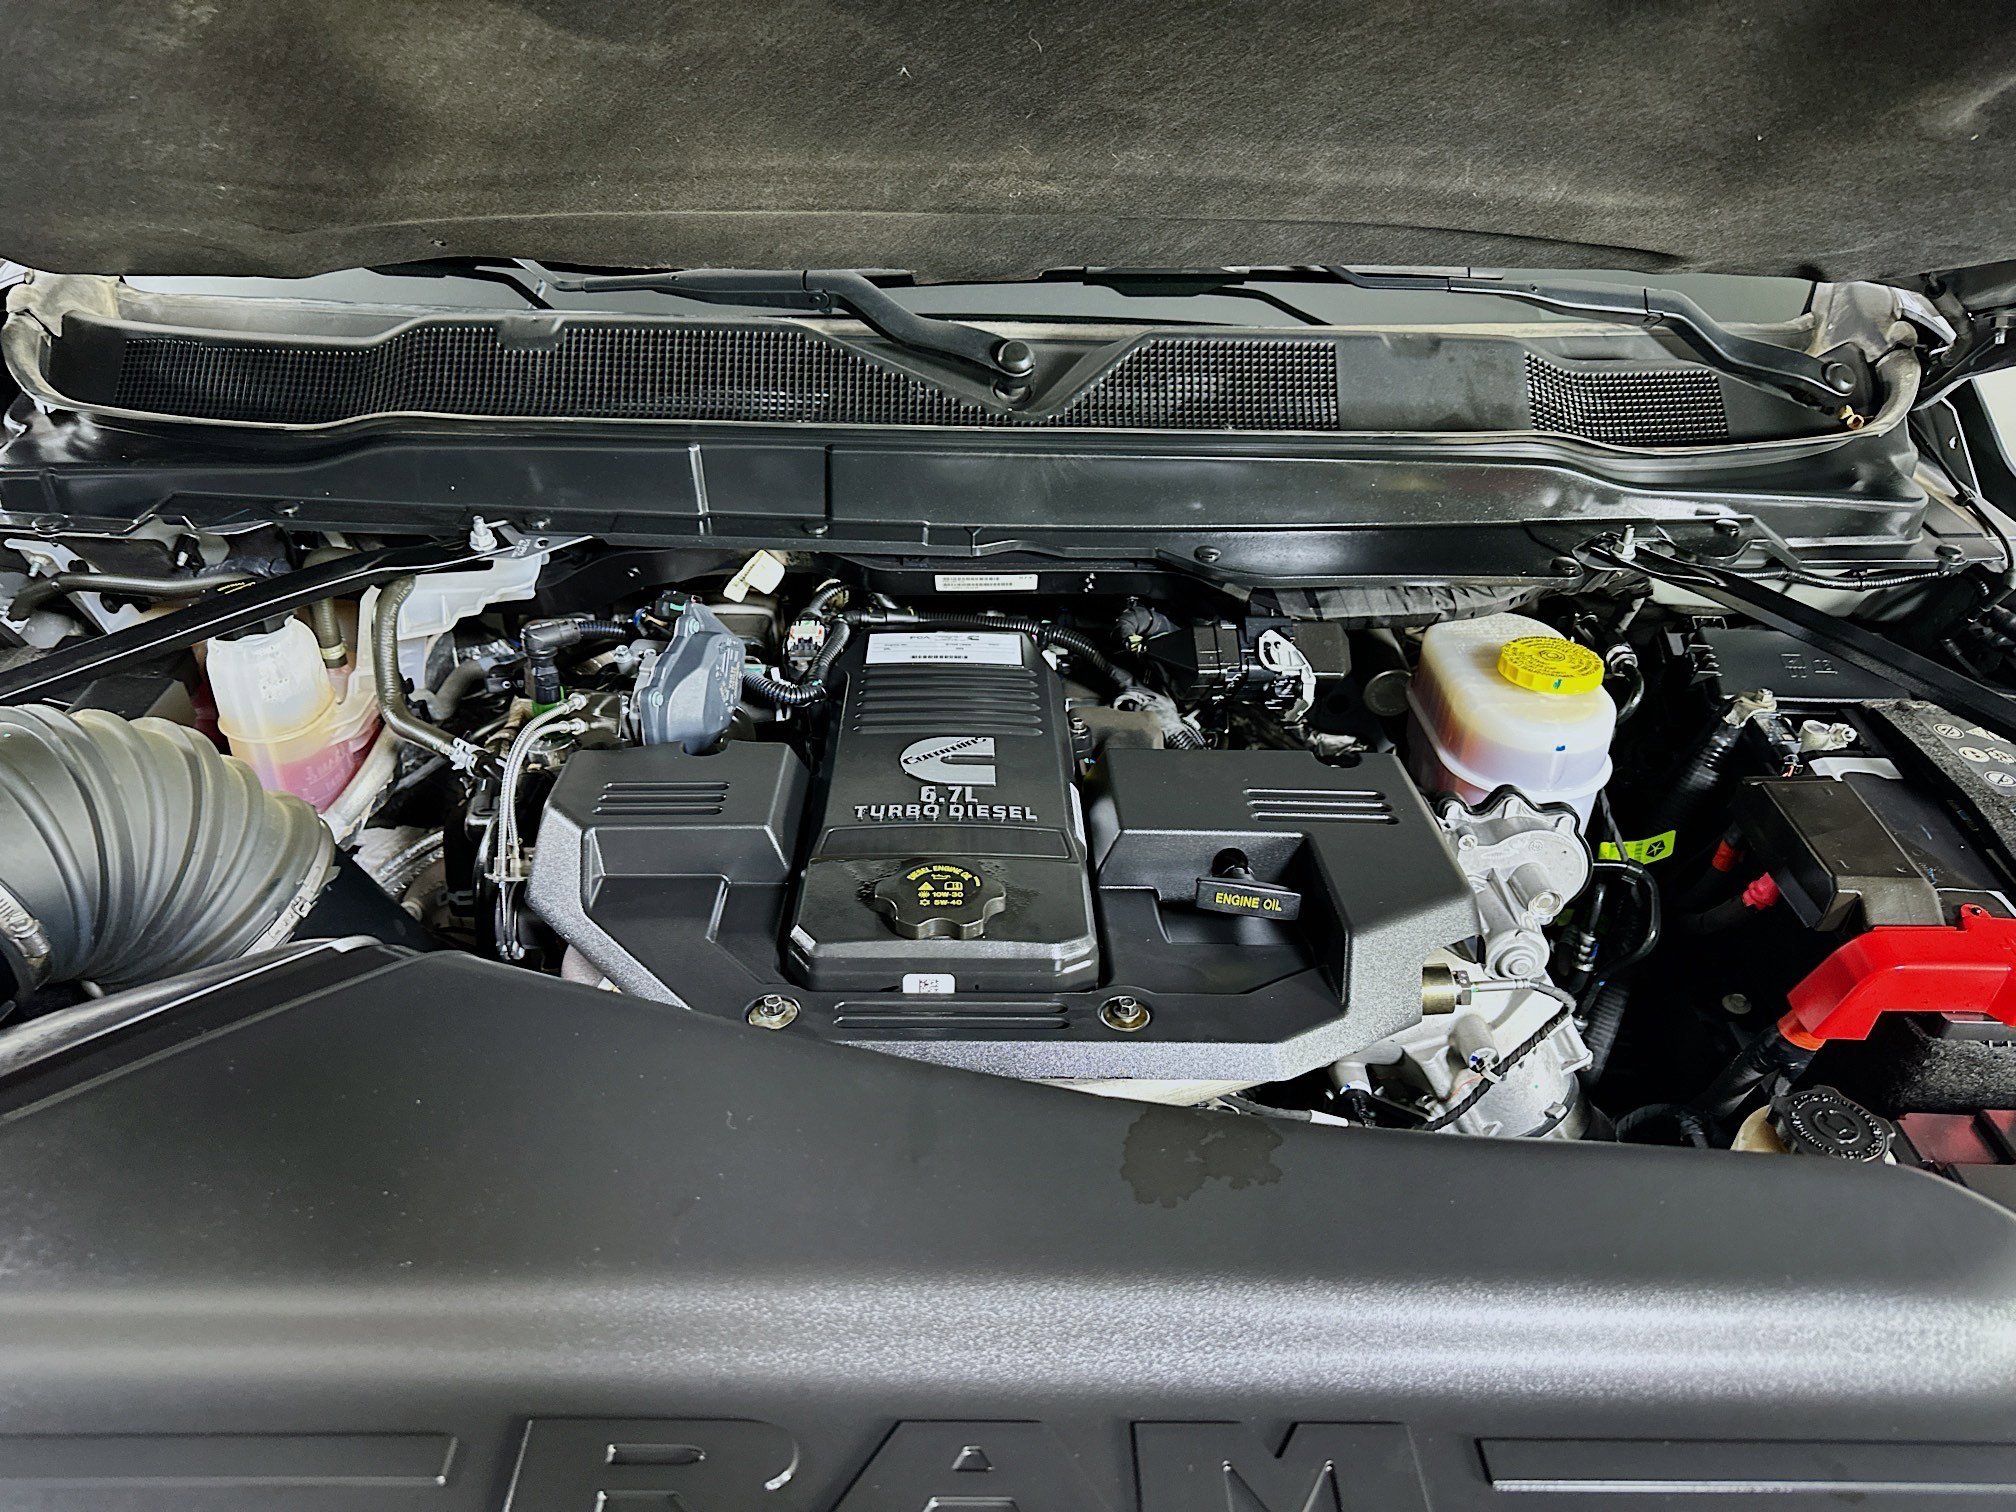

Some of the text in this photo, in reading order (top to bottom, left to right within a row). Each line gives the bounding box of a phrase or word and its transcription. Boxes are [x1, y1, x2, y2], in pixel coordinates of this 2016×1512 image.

[902, 736, 987, 765] Cummins
[920, 785, 979, 804] 6.7L
[854, 804, 1038, 823] TURBO DIESEL
[1215, 891, 1282, 912] ENGINE OIL
[502, 1416, 1433, 1512] RAM
